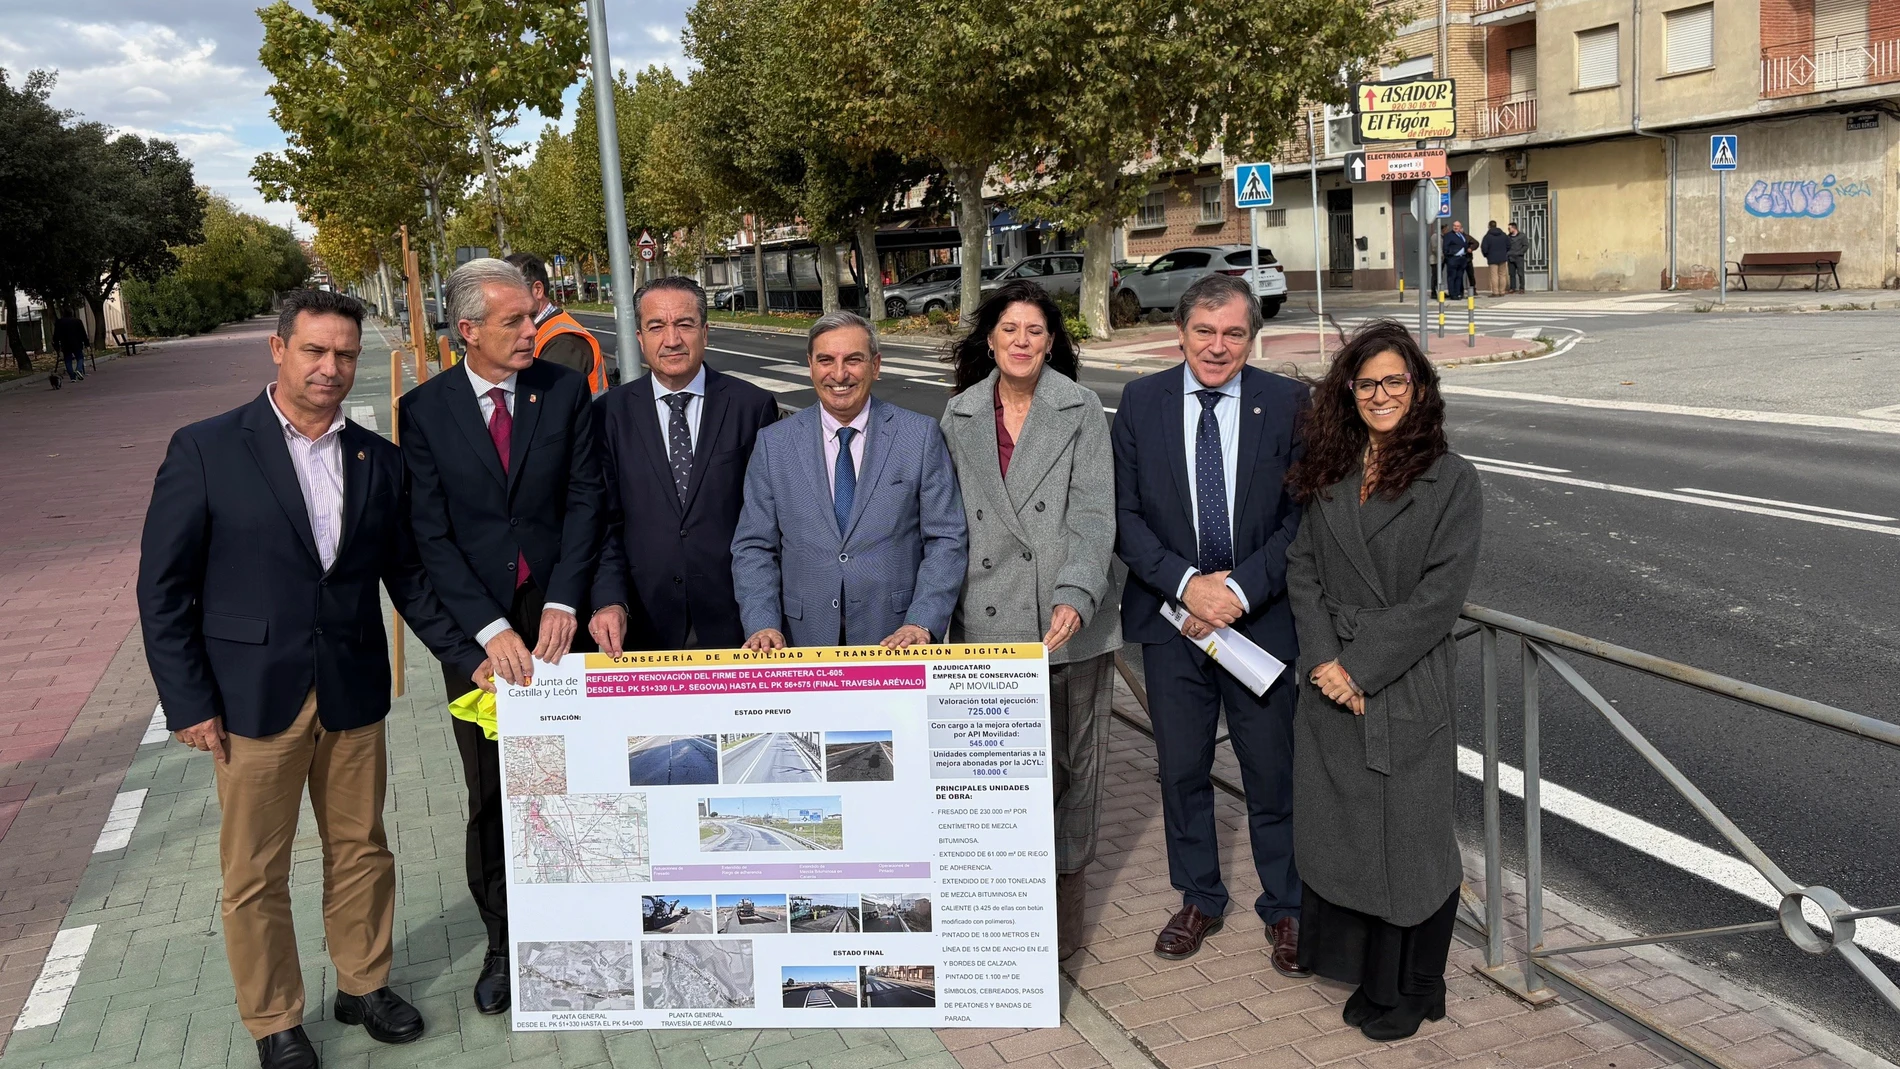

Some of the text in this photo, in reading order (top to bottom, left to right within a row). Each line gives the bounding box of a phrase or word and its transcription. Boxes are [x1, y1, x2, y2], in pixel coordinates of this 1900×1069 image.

[1381, 84, 1447, 103] ASADOR
[1368, 112, 1429, 133] El Figón
[1418, 127, 1450, 136] Arévalo
[1367, 152, 1412, 160] ELECTRÓNICA
[614, 654, 692, 663] CONSEJERÍA
[733, 652, 803, 660] MOVILIDAD
[835, 648, 952, 658] TRANSFORMACIÓN
[536, 676, 578, 686] Junta de
[586, 674, 630, 682] REFUERZO
[639, 672, 692, 682] RENOVACIÓN
[712, 672, 736, 680] FIRME
[764, 669, 814, 678] CARRETERA
[641, 684, 667, 692] 51+330
[689, 684, 728, 692] SEGOVIA)
[812, 680, 838, 689] (FINAL
[841, 678, 880, 686] TRAVESÍA
[882, 678, 925, 686] ARÉVALO)
[508, 688, 578, 698] Castilla y León
[969, 750, 1030, 758] complementarias
